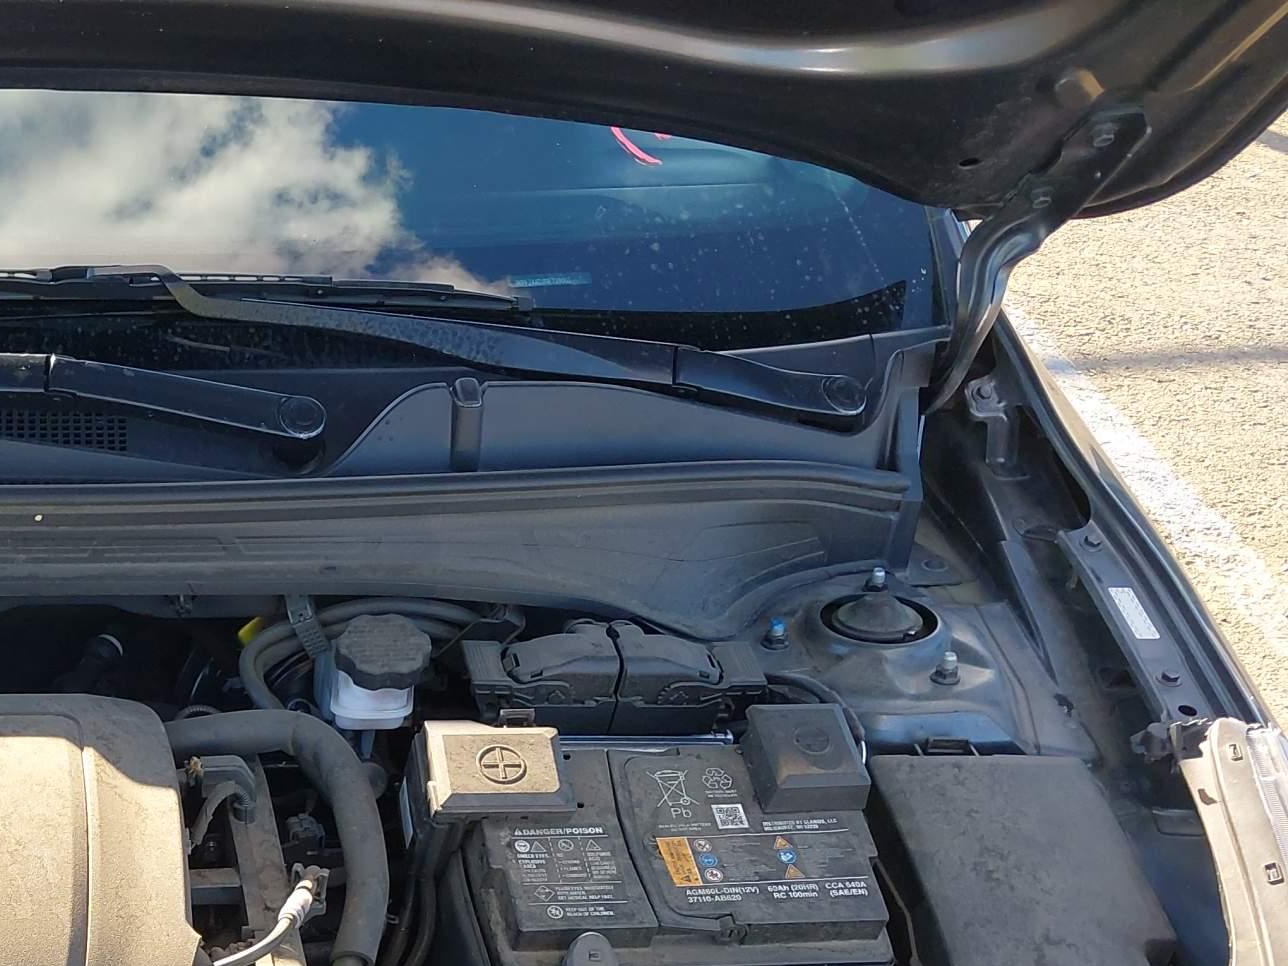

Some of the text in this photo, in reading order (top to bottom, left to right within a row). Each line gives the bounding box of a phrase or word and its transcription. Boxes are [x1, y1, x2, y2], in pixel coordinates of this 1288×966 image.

[670, 807, 692, 818] Pb
[523, 826, 603, 836] DANGER/POISON
[825, 882, 844, 890] CCA
[789, 891, 819, 899] 100min
[829, 887, 869, 898] (SAE/EN)
